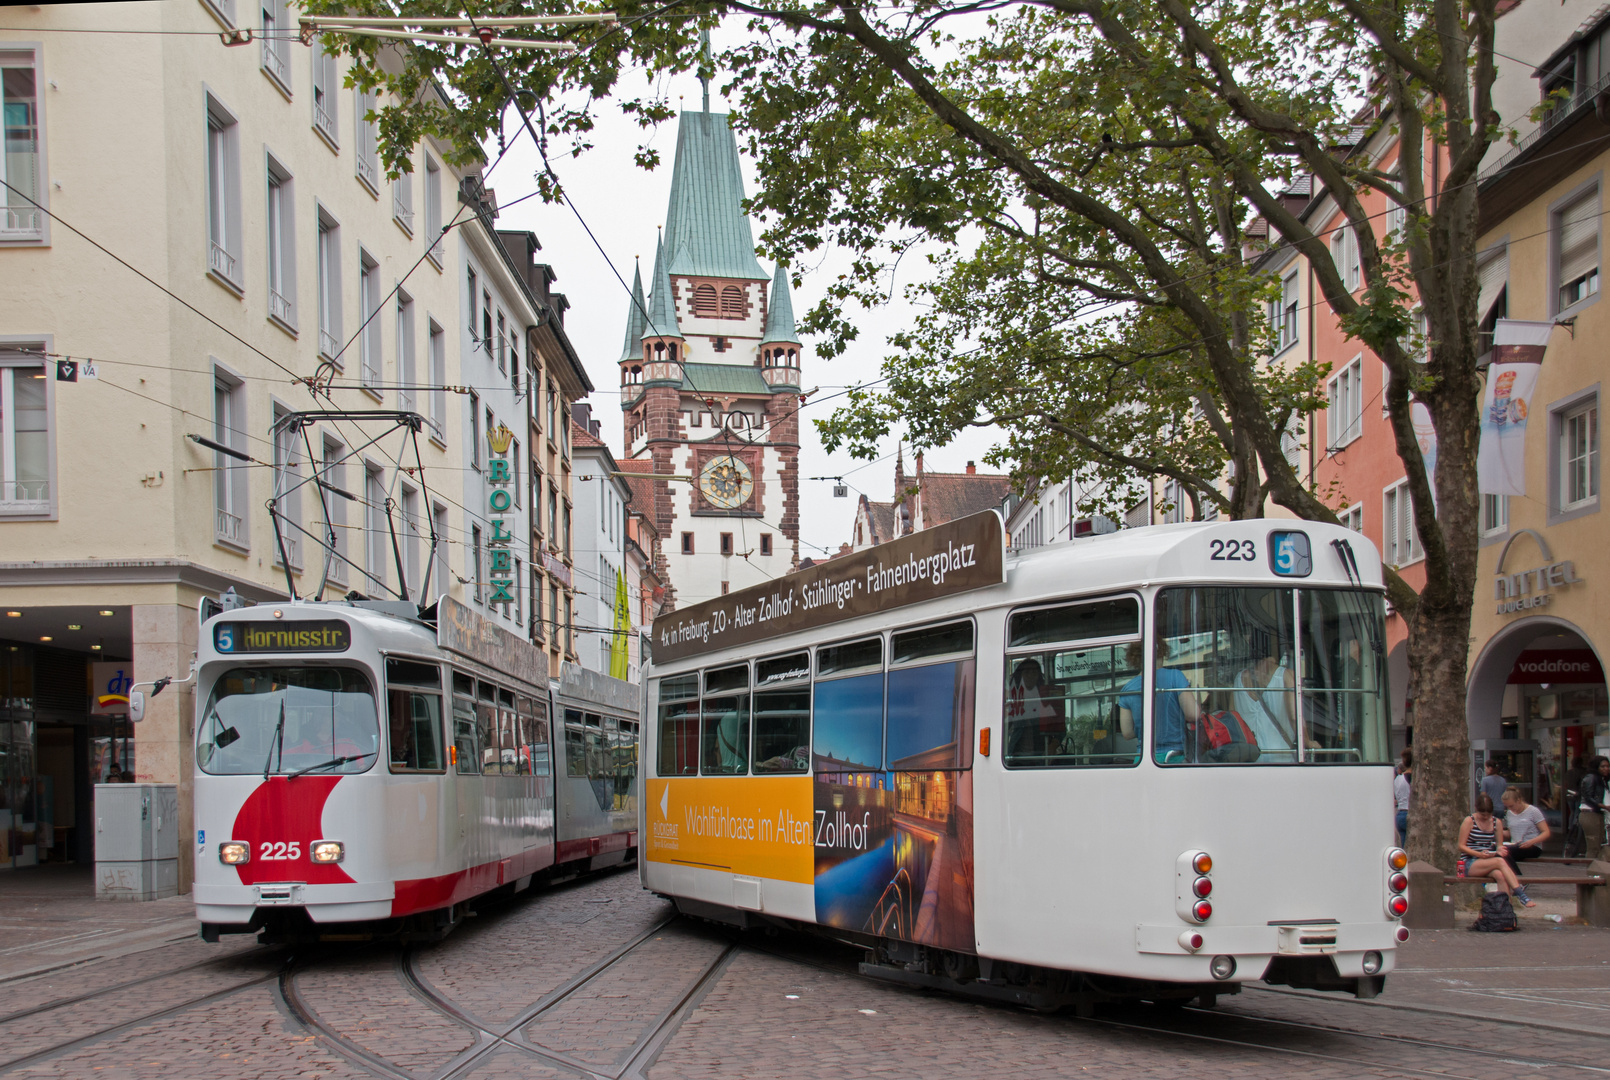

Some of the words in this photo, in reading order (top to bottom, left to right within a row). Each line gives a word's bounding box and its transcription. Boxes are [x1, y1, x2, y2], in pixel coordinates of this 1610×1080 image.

[83, 366, 96, 376] VA
[837, 488, 844, 496] U
[488, 459, 514, 603] ROLEX
[1209, 539, 1256, 561] 223
[1277, 540, 1294, 569] 5
[1494, 560, 1583, 600] NITTEL
[661, 627, 670, 647] 4x
[671, 626, 678, 645] in
[679, 619, 710, 643] Freiburg:
[712, 609, 726, 634] ZO
[734, 603, 756, 629] Alter
[758, 588, 793, 622] Zollhof
[802, 578, 856, 610] Stühlinger
[867, 541, 976, 594] Fahnenbergplatz
[217, 629, 232, 650] 5
[244, 626, 348, 648] Hornusstr.
[1519, 659, 1591, 673] vodafone
[684, 805, 755, 841] Wohlfühloase
[758, 808, 773, 842] im
[776, 808, 811, 846] Alten
[815, 810, 870, 850] Zollhof
[260, 841, 302, 861] 225
